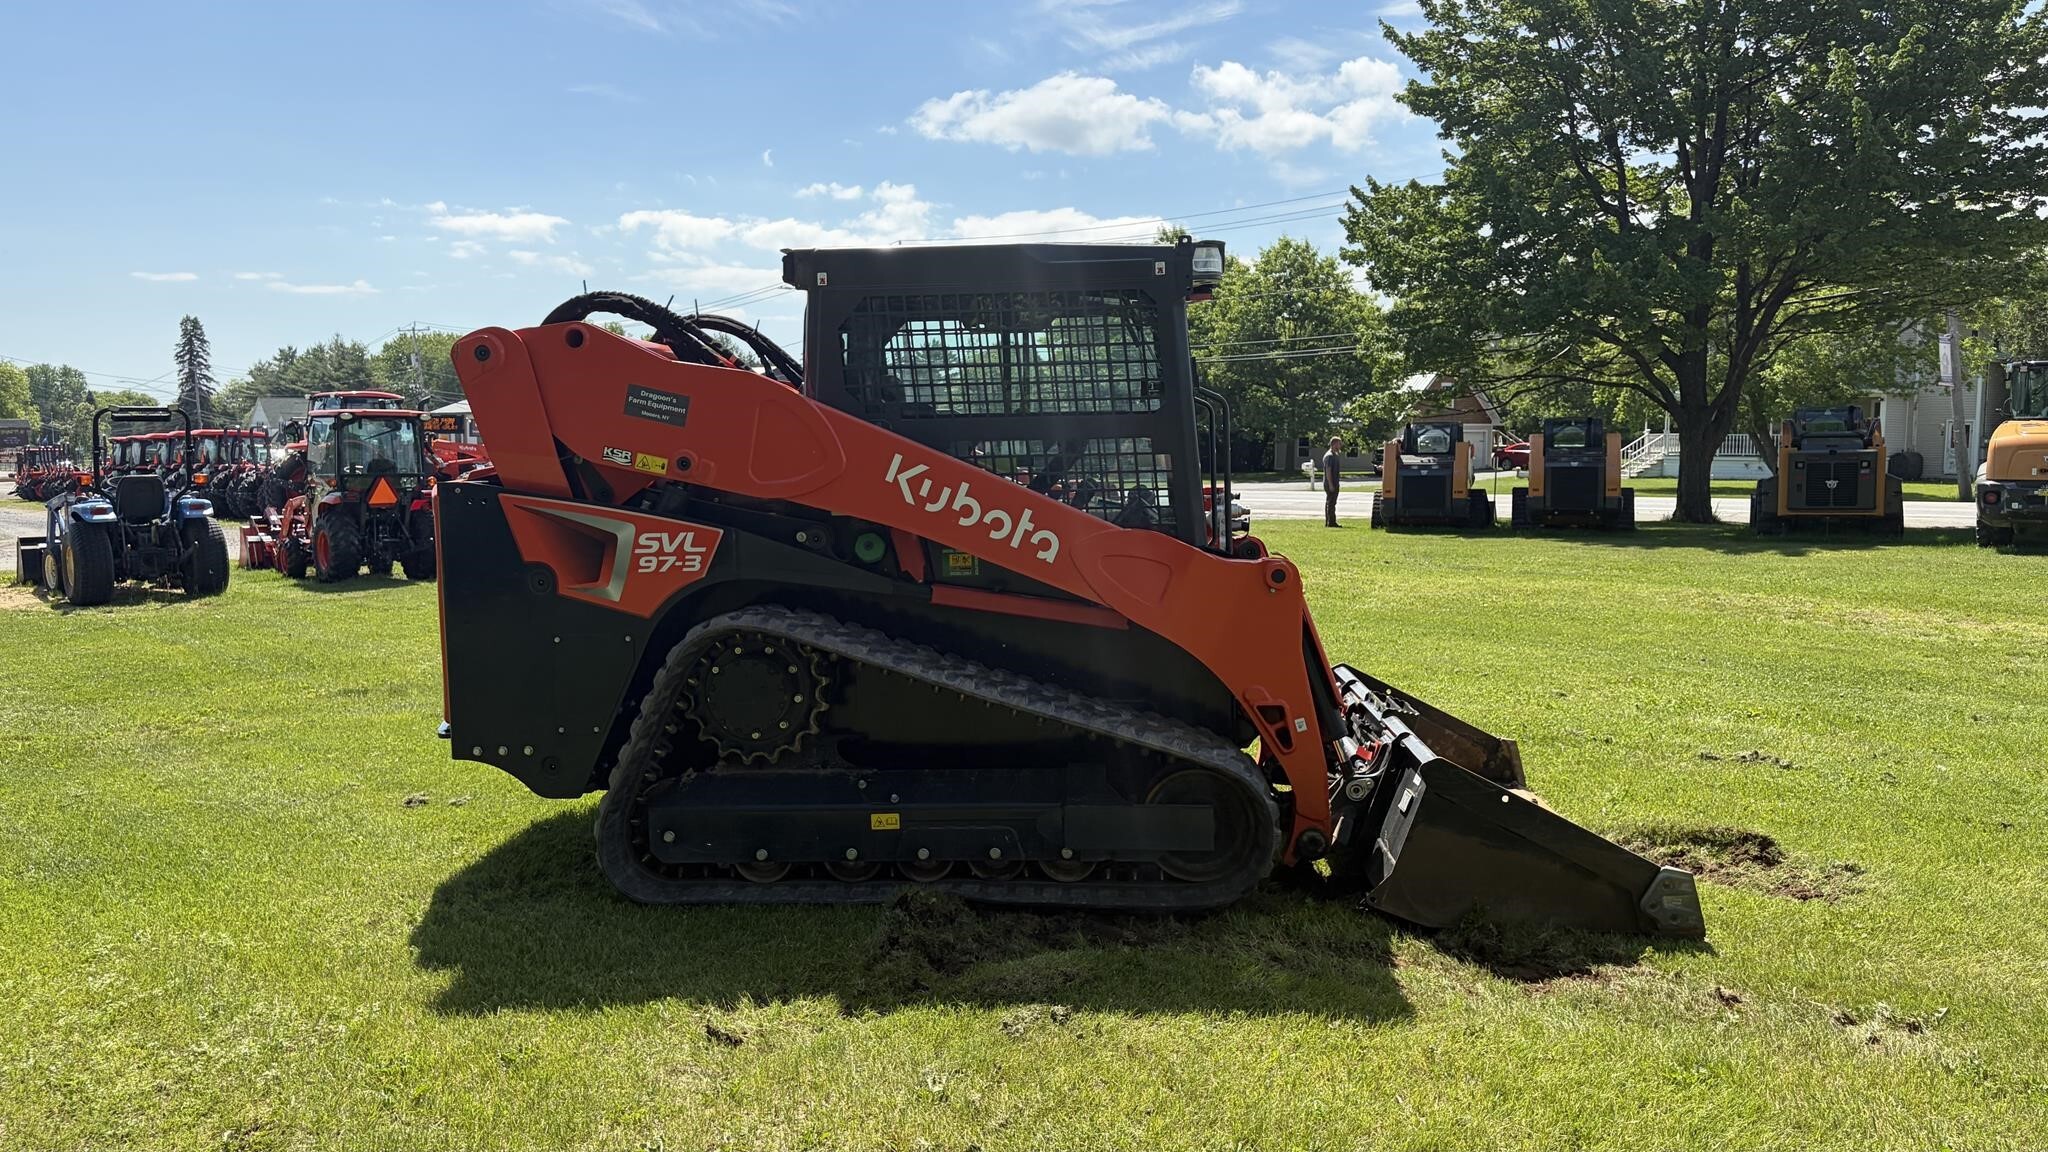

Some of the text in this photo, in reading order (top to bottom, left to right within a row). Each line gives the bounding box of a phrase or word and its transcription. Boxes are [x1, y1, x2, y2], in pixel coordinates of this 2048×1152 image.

[628, 396, 687, 415] Farm Equipment
[640, 390, 677, 404] Dragoon's
[603, 446, 632, 460] KSR
[885, 453, 1060, 564] Kubota
[635, 532, 707, 553] SVL
[638, 555, 702, 573] 97-3
